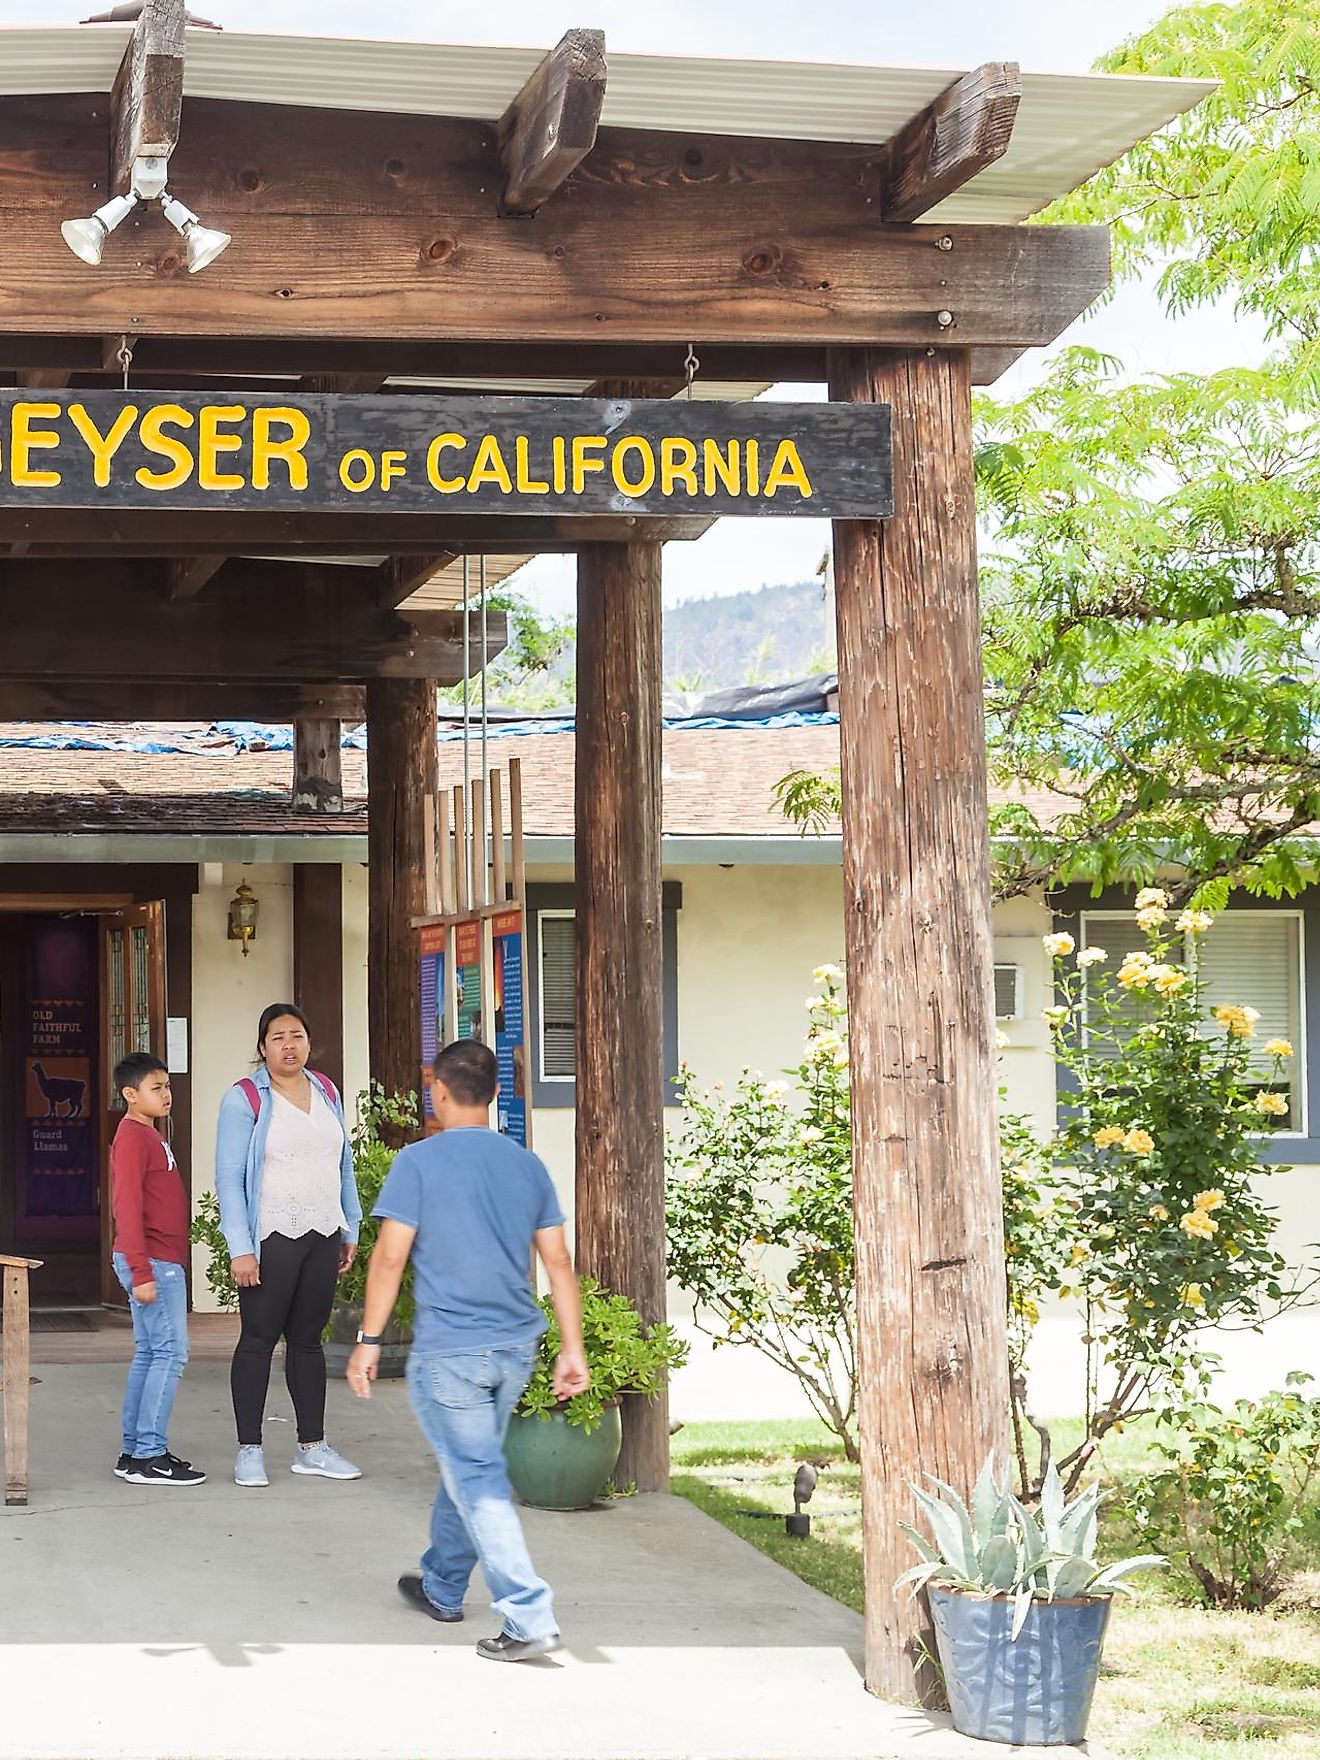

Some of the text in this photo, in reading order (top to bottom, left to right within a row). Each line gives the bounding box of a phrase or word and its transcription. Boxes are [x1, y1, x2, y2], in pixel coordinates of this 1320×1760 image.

[340, 449, 408, 492] OF
[426, 433, 813, 499] CALIFORNIA
[33, 1011, 53, 1020] OLD
[33, 1023, 82, 1032] FAITHFUL
[33, 1035, 60, 1044] FARM
[33, 1130, 62, 1139] Guard
[34, 1142, 68, 1152] Llamas
